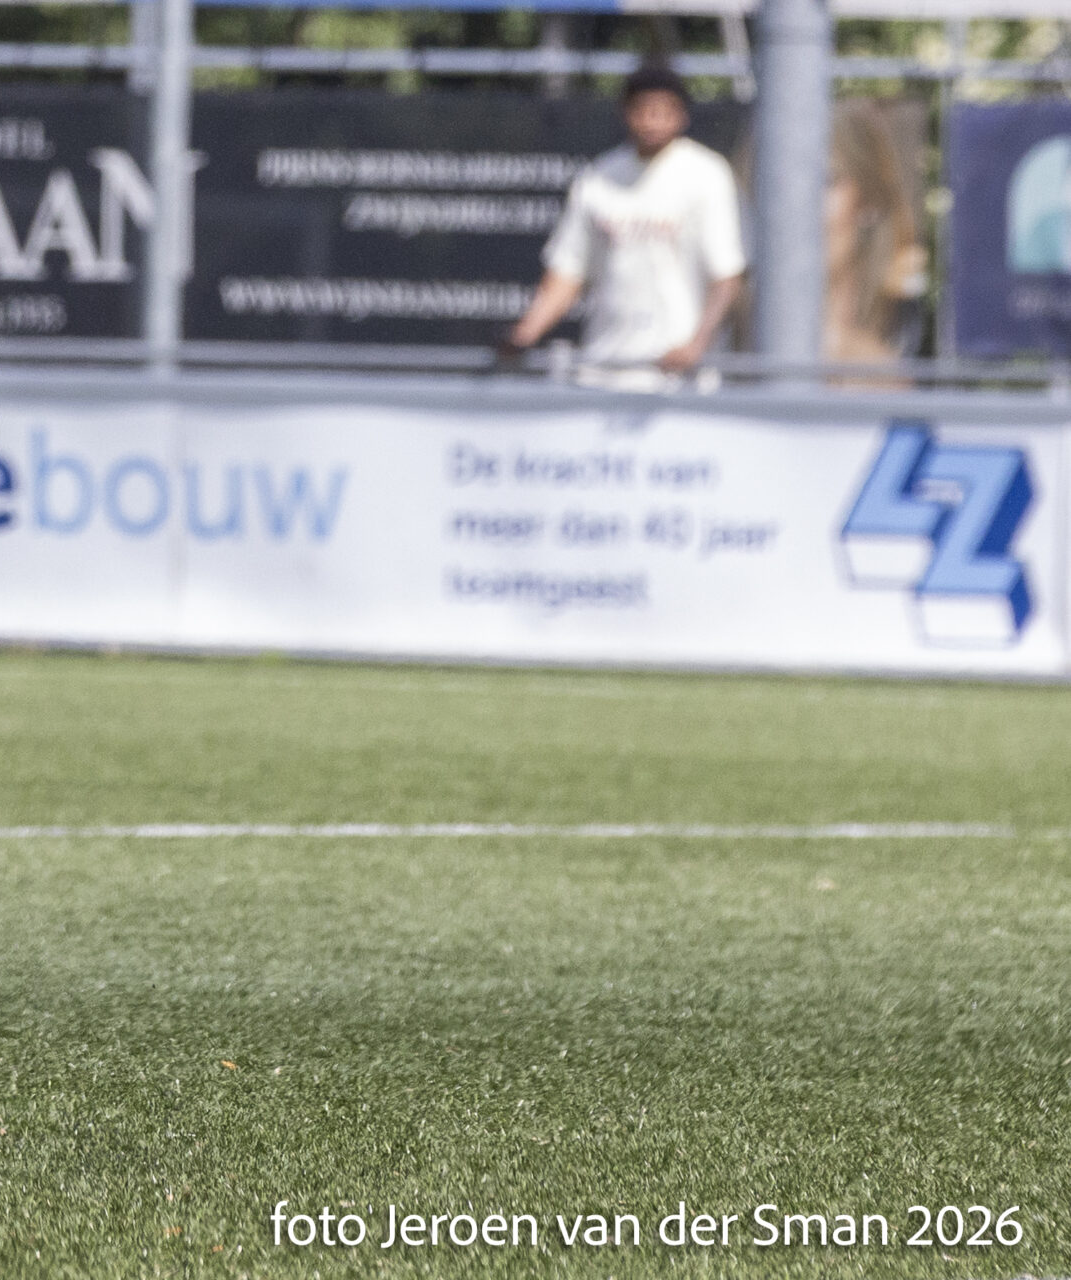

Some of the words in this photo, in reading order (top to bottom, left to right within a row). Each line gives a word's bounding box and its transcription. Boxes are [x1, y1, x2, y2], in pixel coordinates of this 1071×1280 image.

[446, 441, 502, 485] De
[649, 454, 718, 488] van
[447, 508, 546, 544] meer
[556, 501, 625, 545] dan
[698, 511, 780, 558] jaar
